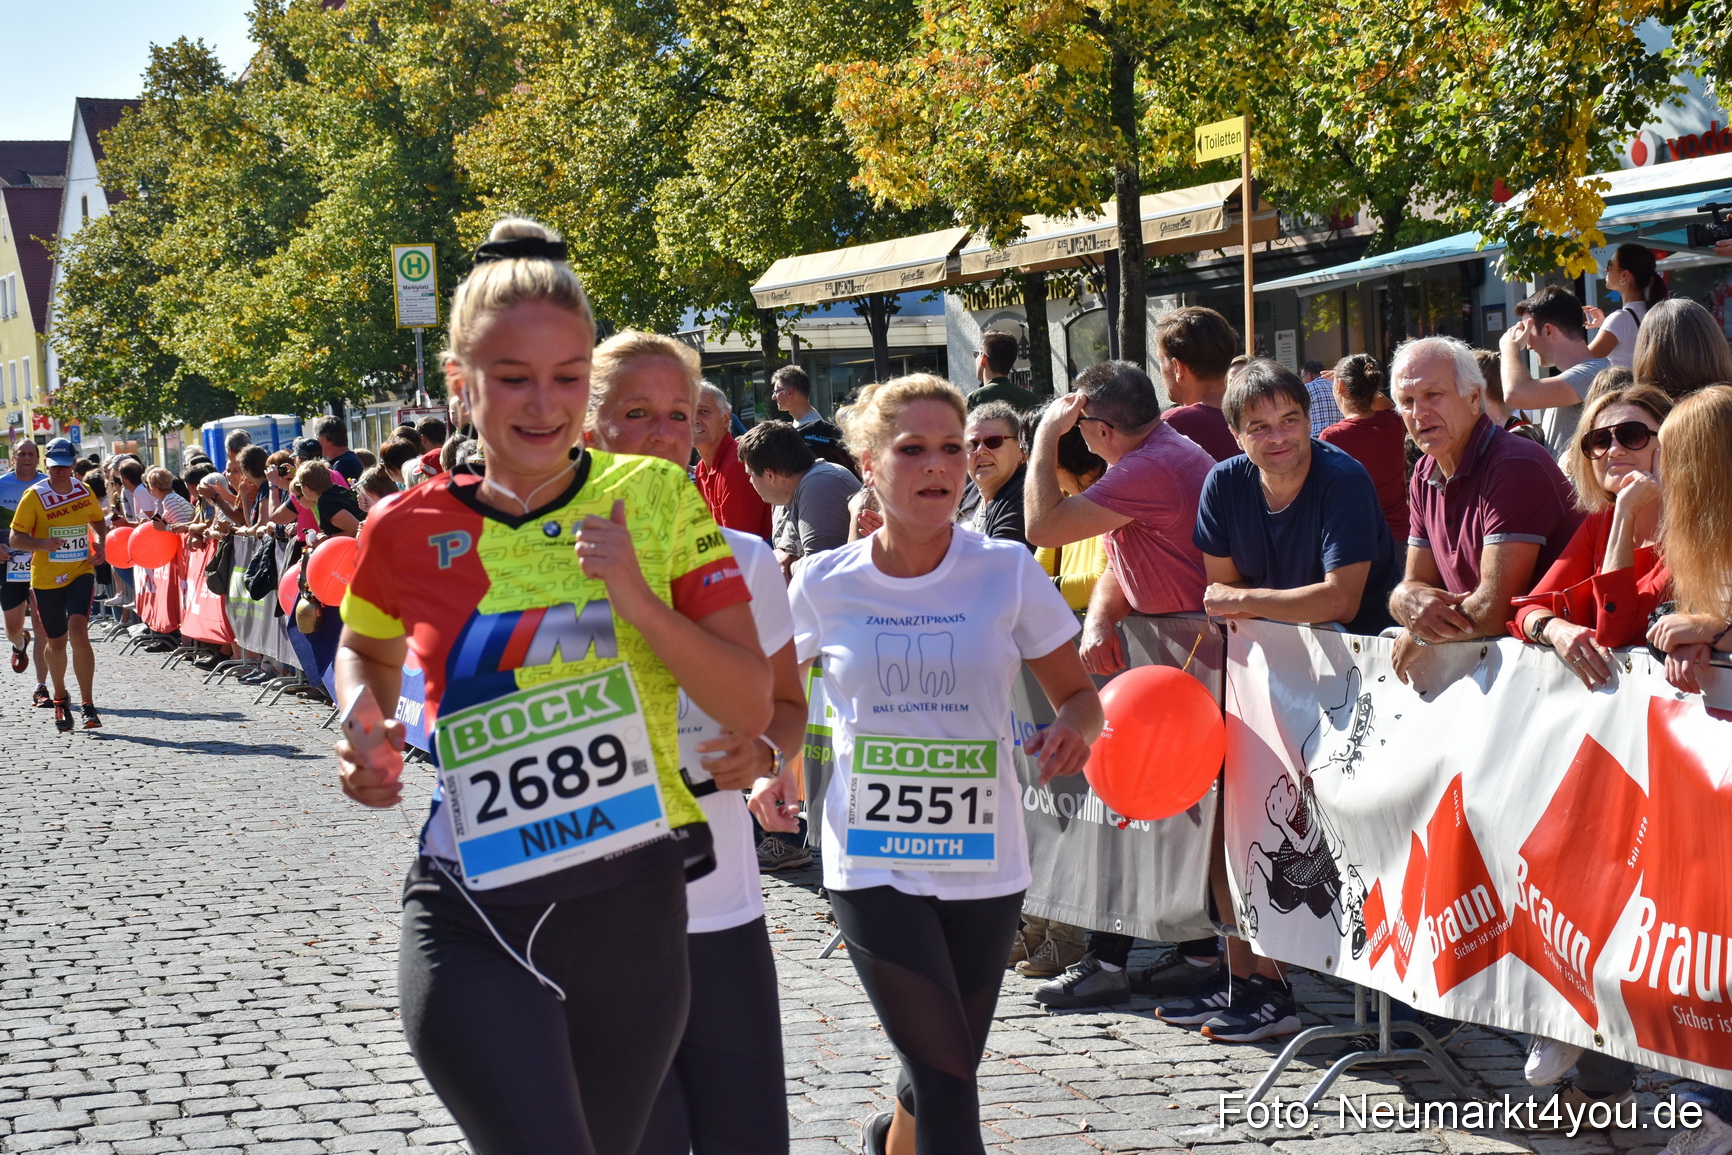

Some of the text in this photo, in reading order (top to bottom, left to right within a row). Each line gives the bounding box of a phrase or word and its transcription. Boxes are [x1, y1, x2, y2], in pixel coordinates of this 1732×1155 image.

[1204, 131, 1241, 150] Toiletten
[407, 257, 422, 274] H
[46, 500, 91, 520] MAX BÖGL
[53, 527, 85, 537] BOCK
[58, 537, 85, 550] 410
[55, 551, 84, 559] ANDREAS
[866, 613, 966, 627] ZAHNARZTPRAXIS
[450, 679, 616, 758] BOCK
[873, 702, 969, 714] RALF GÜNTER HELM
[864, 743, 984, 771] BOCK
[470, 734, 627, 824] 2689
[866, 783, 977, 825] 2551
[519, 807, 615, 857] NINA
[1627, 816, 1649, 868] Seit 1929
[880, 837, 963, 855] JUDITH
[1425, 884, 1497, 961] Braun
[1516, 854, 1591, 982] Braun
[1454, 936, 1478, 959] Sicher
[1478, 932, 1489, 945] ist
[1620, 896, 1732, 1003] Brau
[1543, 942, 1562, 973] Sicher
[1564, 967, 1574, 984] ist
[1673, 1005, 1714, 1032] Sicher
